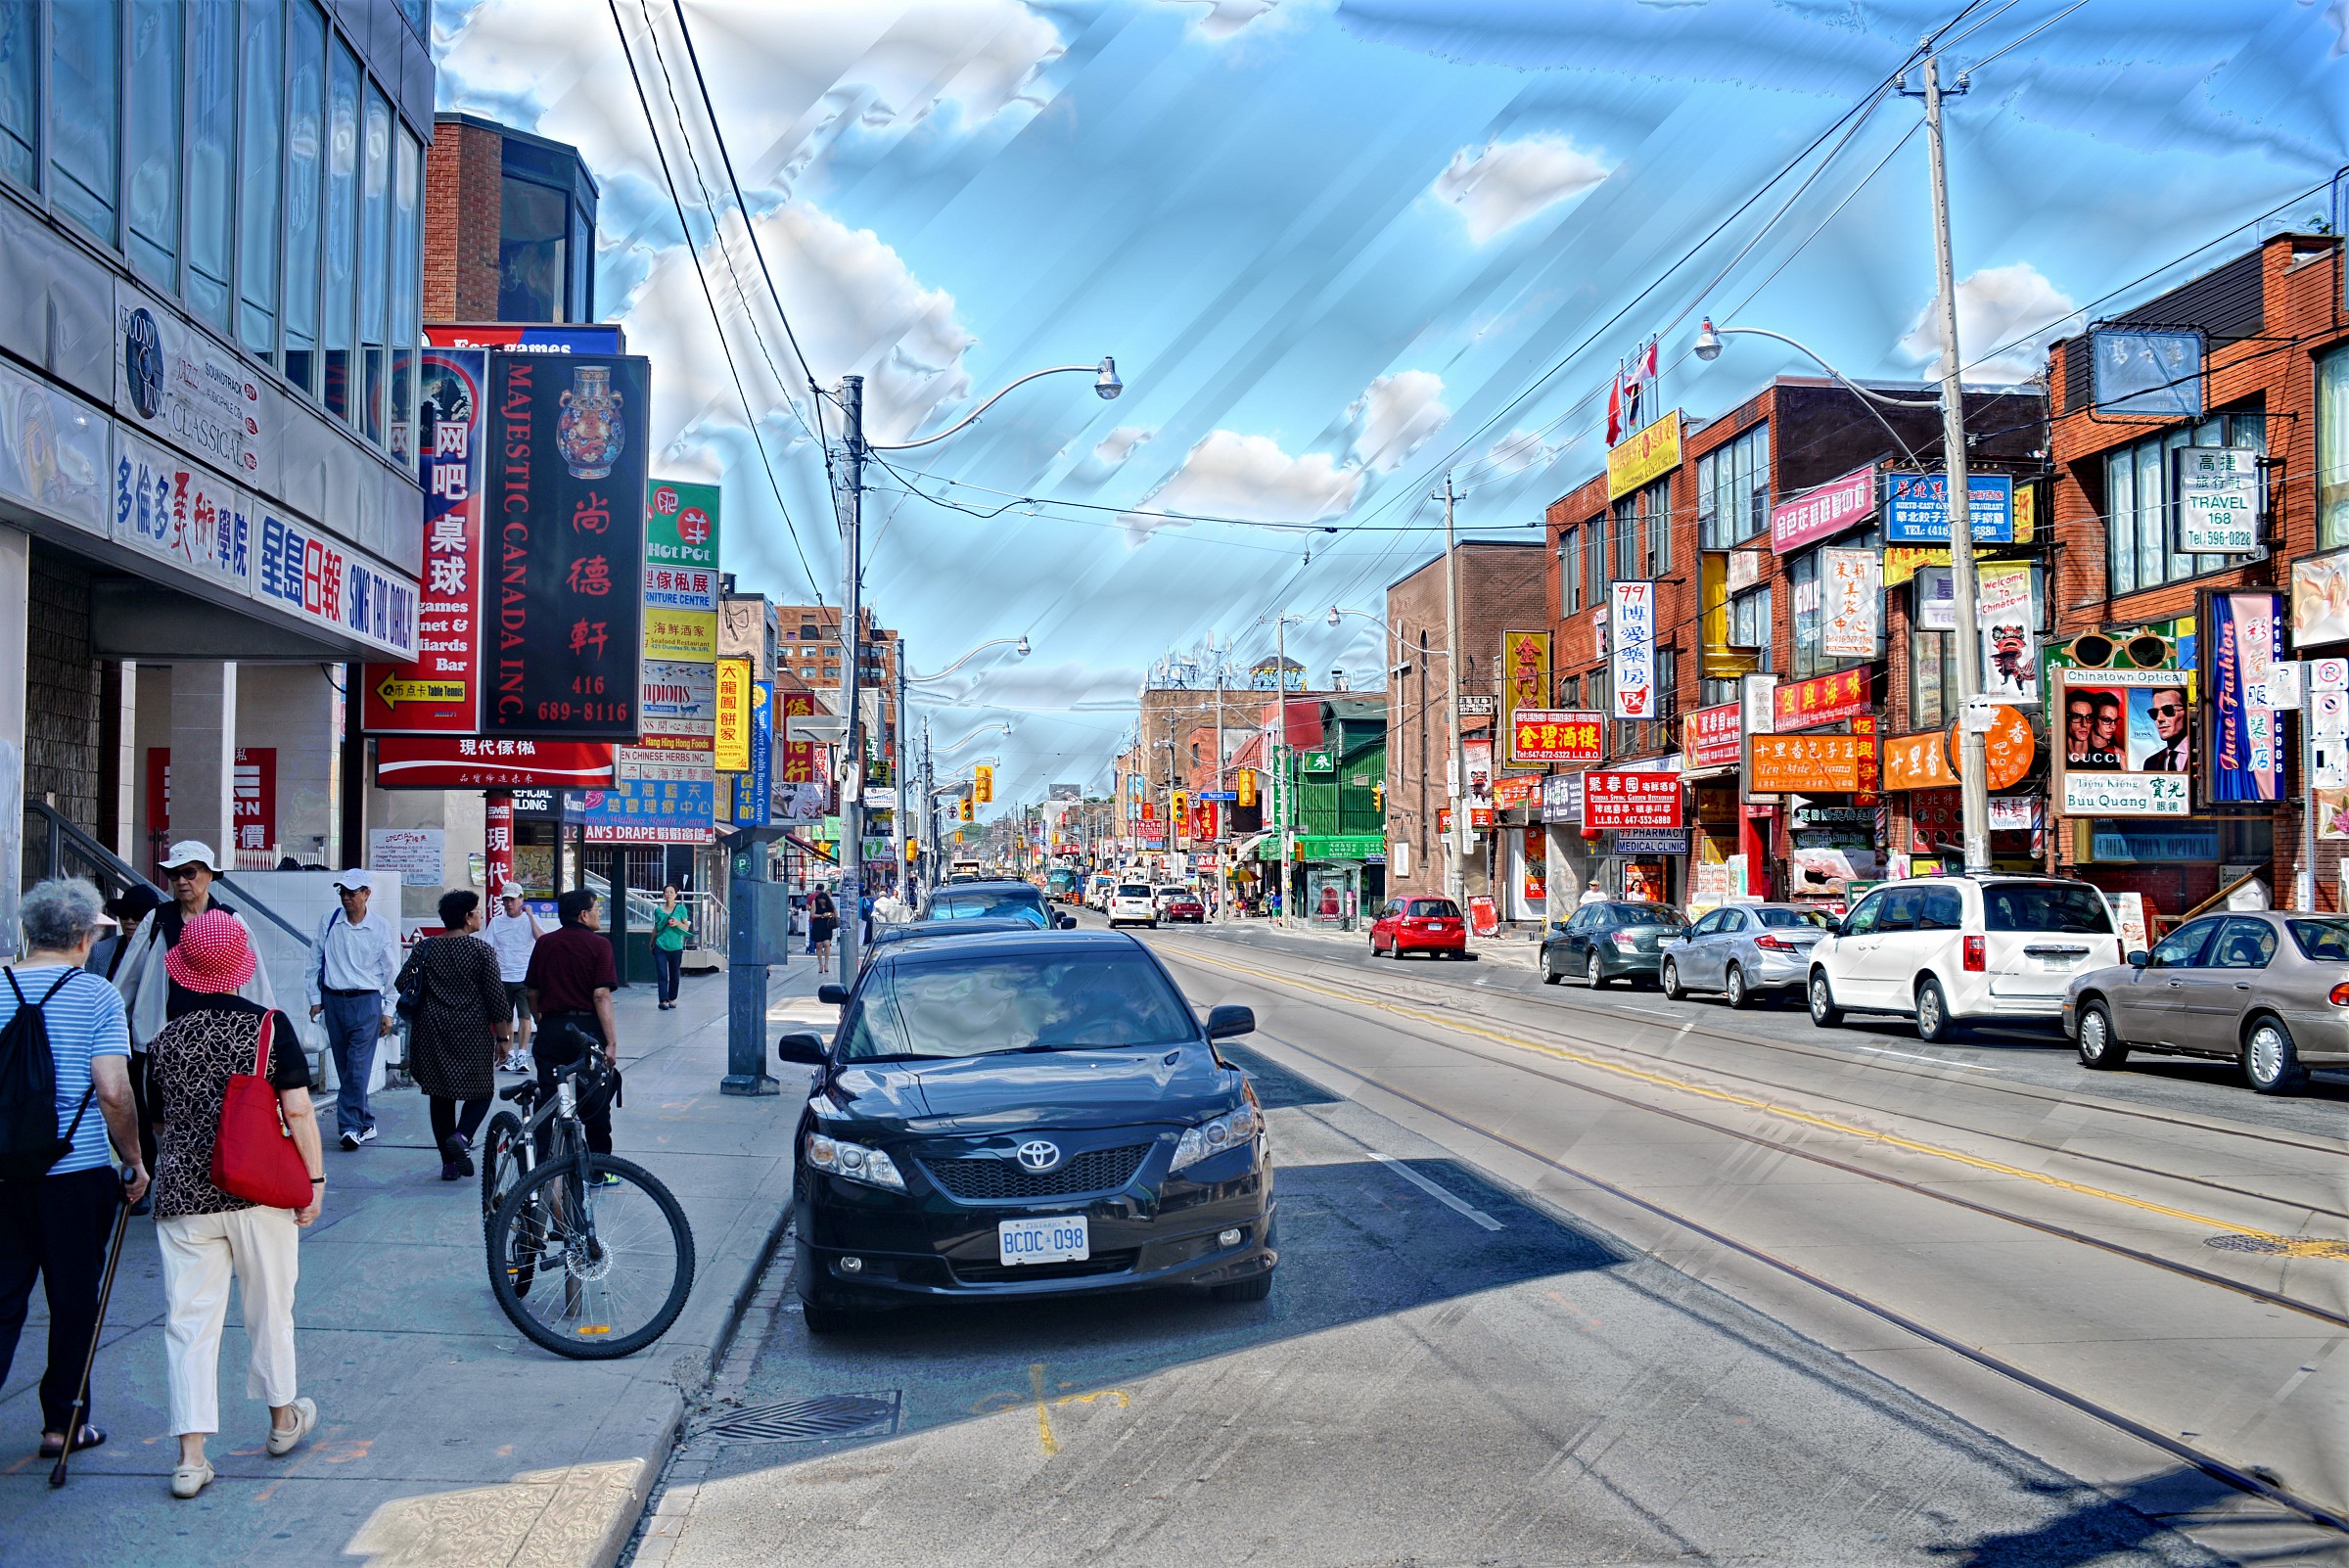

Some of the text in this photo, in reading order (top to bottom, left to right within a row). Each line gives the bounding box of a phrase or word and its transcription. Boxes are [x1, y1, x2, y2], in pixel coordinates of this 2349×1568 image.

[205, 362, 243, 397] SOUNDTRACK
[172, 403, 244, 468] CLASSICAL
[2198, 453, 2236, 472] 高捷
[2195, 475, 2241, 489] 旅行社
[428, 420, 469, 595] 网吧桌球
[2189, 495, 2248, 510] TRAVEL
[2208, 512, 2233, 525] 168
[1904, 525, 1925, 535] TEL:
[496, 362, 533, 725] MAJESTIC CANADA INC.
[261, 516, 341, 623] 星島日報
[564, 490, 612, 662] 尚德軒
[1836, 561, 1866, 580] 茉莉
[1983, 572, 2024, 590] Welcome
[679, 594, 710, 607] CENTRE
[1618, 585, 1646, 602] 99
[349, 564, 413, 651] SING TAO DAILY
[1982, 593, 2029, 614] Chinatown
[452, 619, 468, 632] &
[654, 622, 705, 637] 海鮮酒家
[1834, 618, 1867, 633] 中心
[651, 637, 711, 647] Seafood Restaurant
[1621, 604, 1647, 685] 博愛藥房
[436, 658, 468, 671] Bar
[2068, 670, 2184, 683] Chinatown Optical
[428, 685, 464, 698] Table Tennis
[572, 675, 605, 695] 416
[2218, 621, 2239, 770] June Fashion
[536, 700, 627, 722] 689-8116
[646, 736, 661, 749] Hang
[675, 738, 691, 750] Hong
[692, 739, 710, 749] Foods
[1517, 724, 1600, 750] 金碧酒樓
[459, 739, 536, 756] 現代傢俬
[1755, 741, 1855, 760] 十里香包子王
[632, 749, 665, 761] CHINESE
[666, 751, 690, 762] HERBS
[692, 752, 707, 762] INC.
[2070, 753, 2121, 763] GUCCI
[1759, 762, 1852, 774] Ten Mile Aroma
[756, 772, 765, 797] Beauty
[2149, 776, 2187, 799] 寶光
[2098, 795, 2147, 809] Quang
[2156, 801, 2179, 812] 眼鏡
[757, 798, 765, 822] Centre
[1625, 815, 1672, 824] 647-352-6888
[1993, 818, 2018, 828] Salon
[617, 826, 656, 840] DRAPE
[1633, 828, 1684, 838] PHARMACY
[1797, 832, 1866, 844] Summer Sun Spa
[1620, 842, 1685, 852] MEDICAL CLINIC
[1003, 1227, 1084, 1254] BCDC 098
